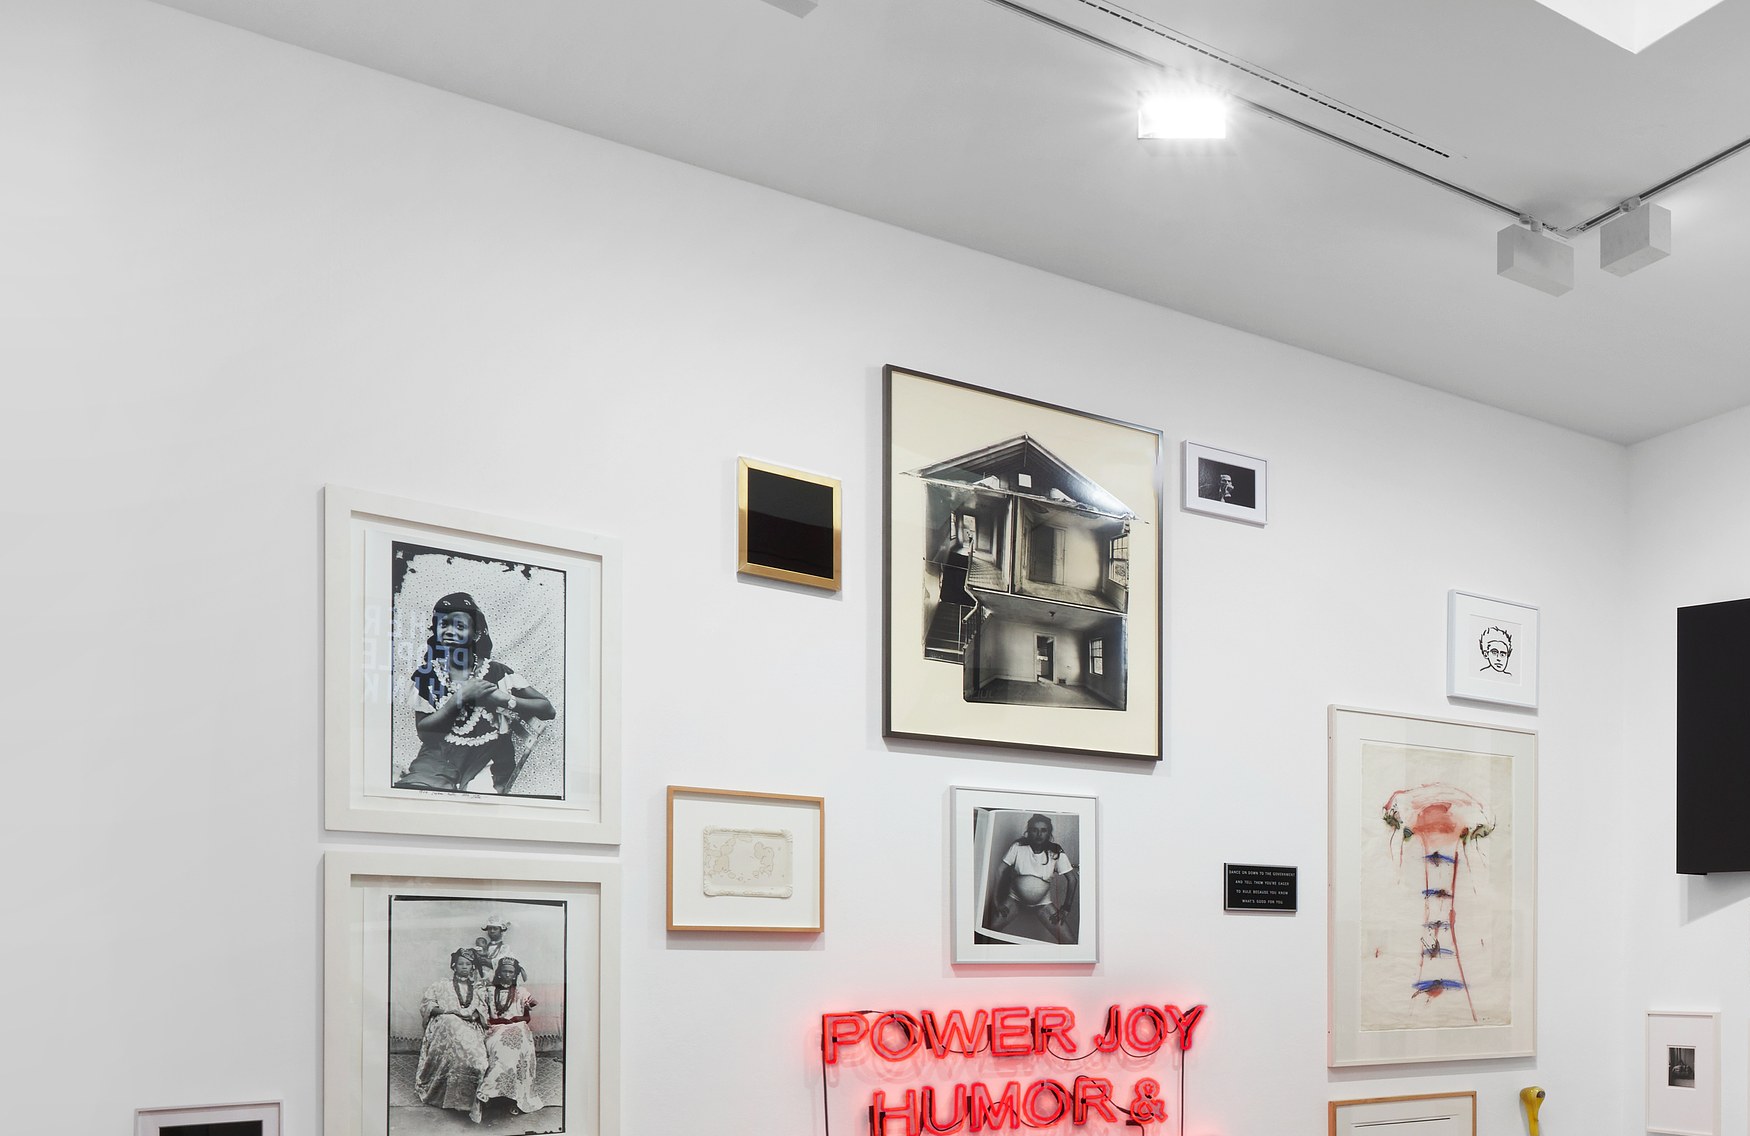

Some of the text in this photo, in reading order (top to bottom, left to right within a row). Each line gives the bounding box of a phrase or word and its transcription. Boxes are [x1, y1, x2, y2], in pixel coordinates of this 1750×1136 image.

[821, 1004, 1208, 1065] POWER JOY
[1129, 1077, 1169, 1125] &
